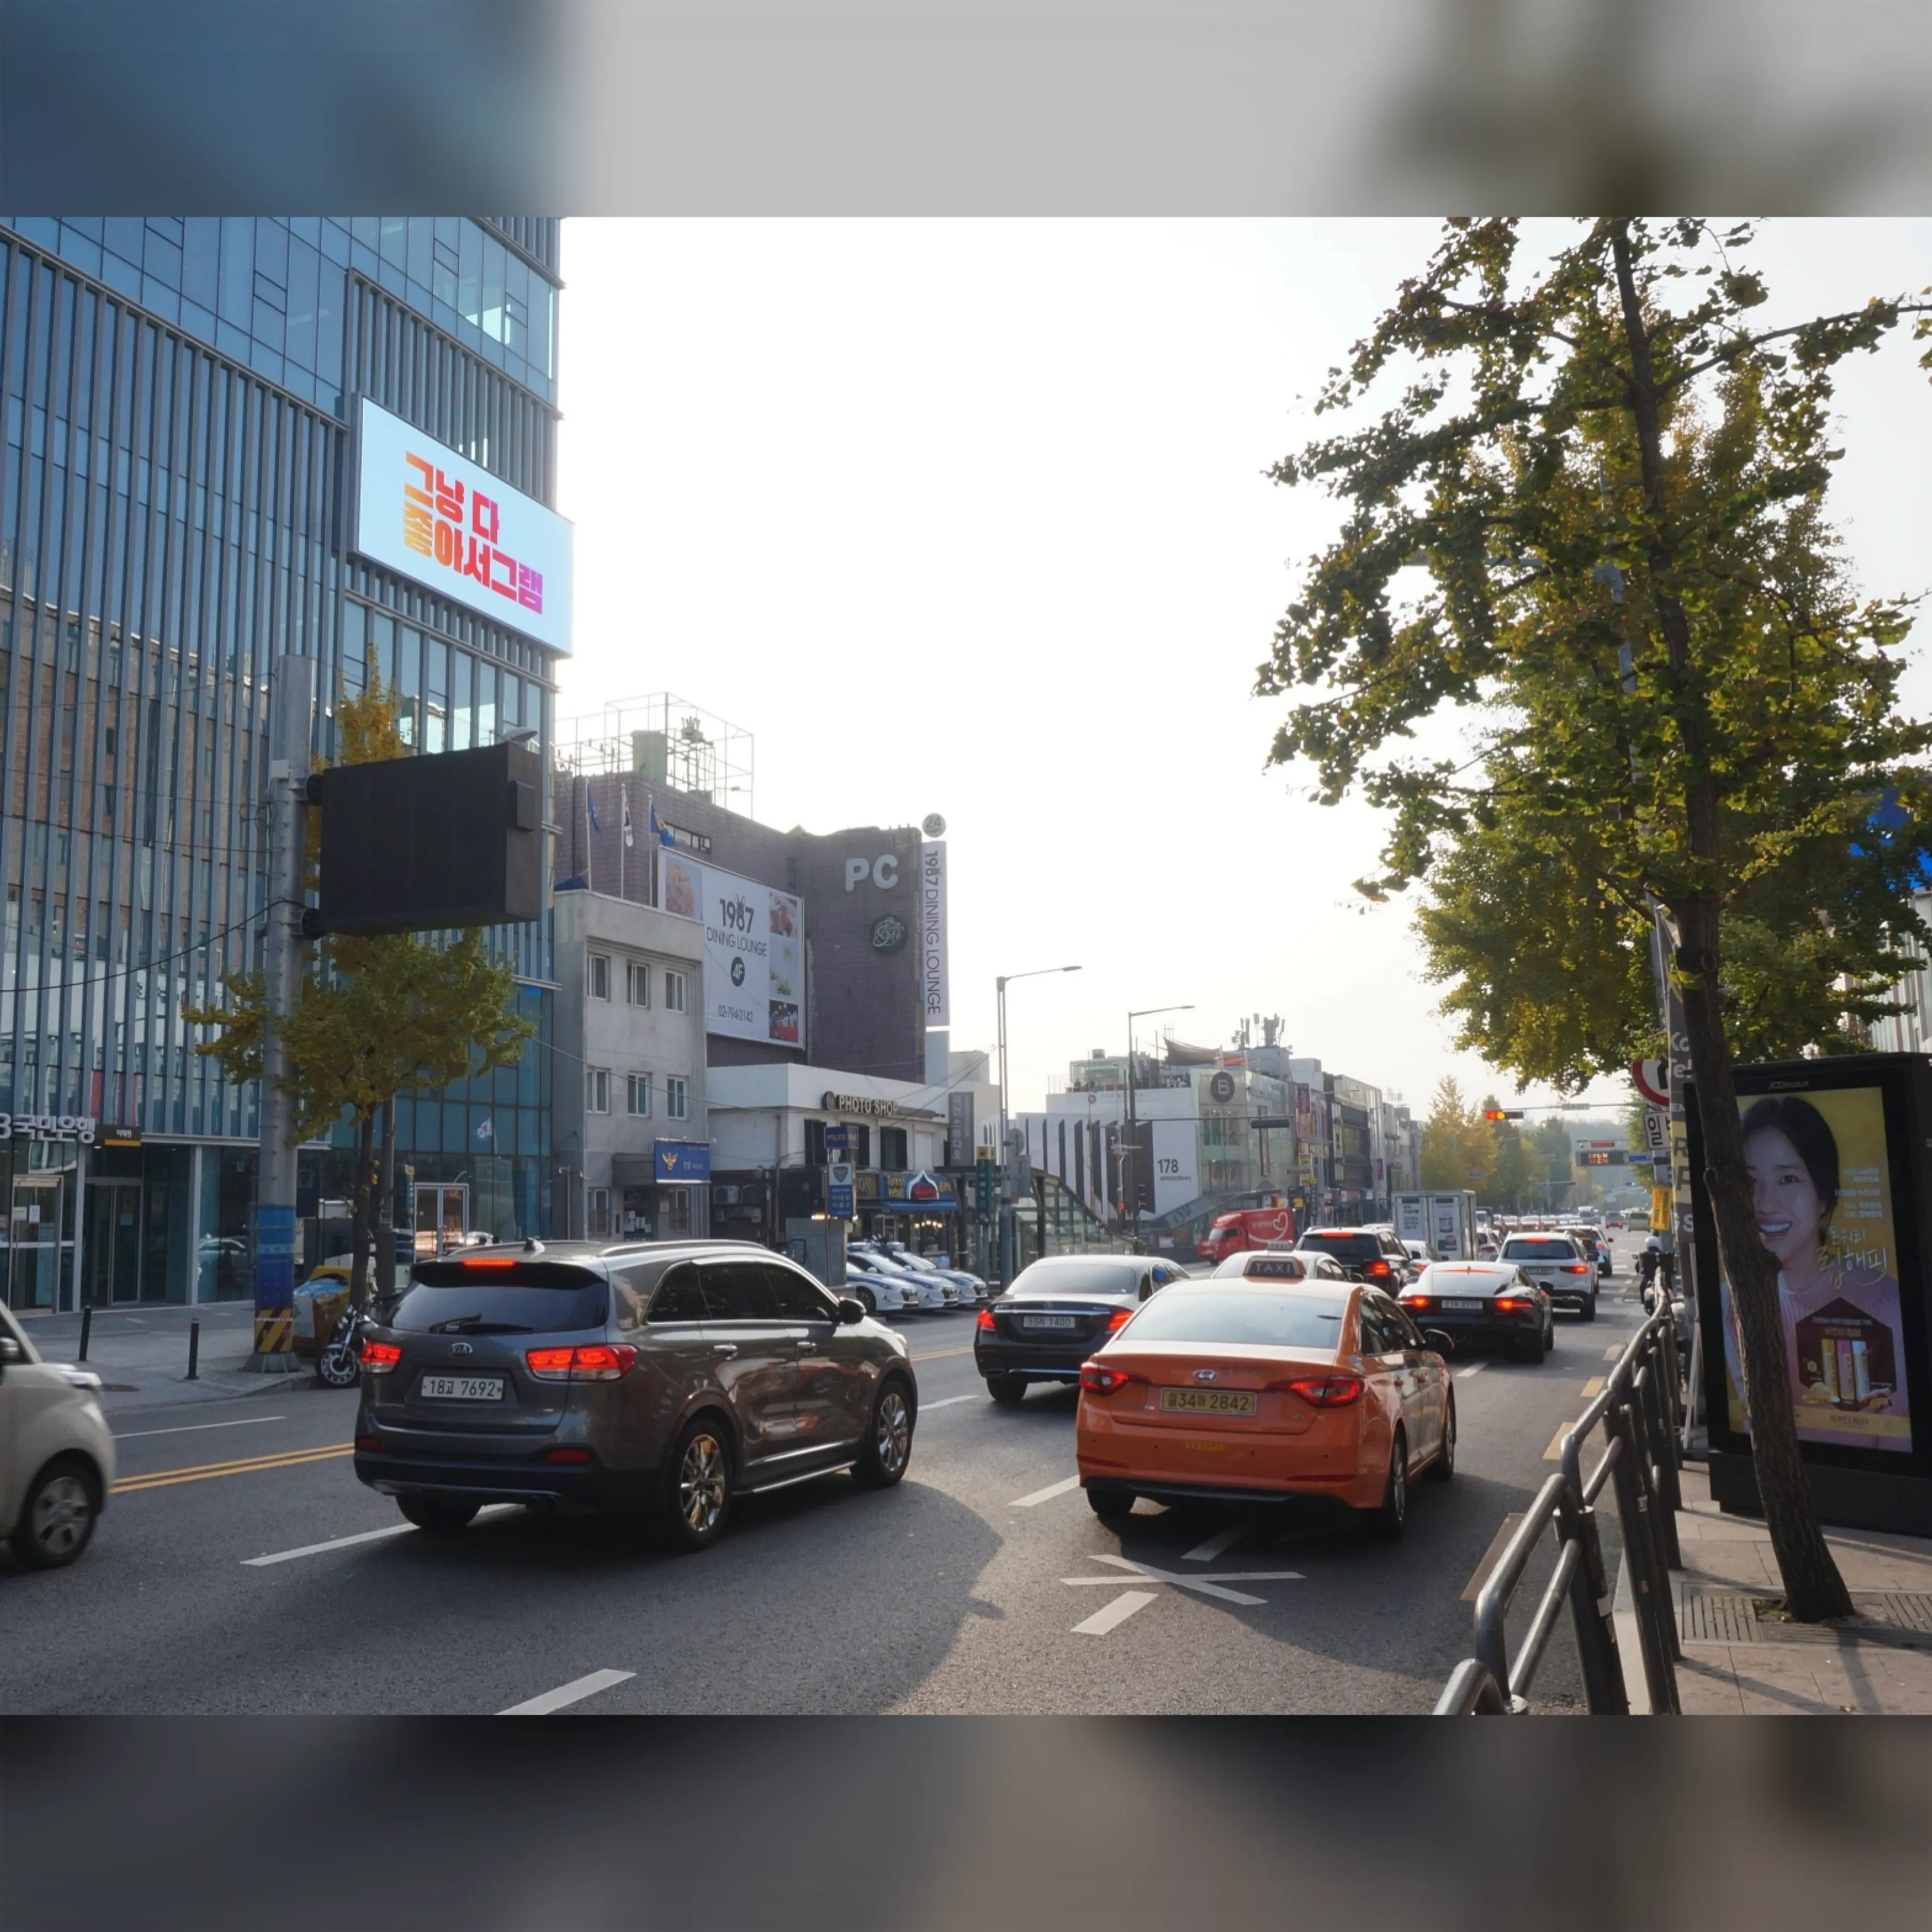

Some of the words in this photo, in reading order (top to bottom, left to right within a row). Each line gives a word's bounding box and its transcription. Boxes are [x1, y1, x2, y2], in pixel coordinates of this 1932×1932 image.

[404, 451, 464, 523] 그냥
[471, 488, 499, 545] 다
[845, 854, 898, 892] PC
[925, 851, 941, 886] 1987
[719, 895, 755, 934] 1987
[926, 890, 939, 945] DINING
[707, 927, 736, 947] DINING
[737, 937, 767, 956] LOUNGE
[926, 950, 940, 1014] LOUNGE
[1217, 1080, 1230, 1095] B
[839, 1095, 872, 1114] PHOTO
[874, 1100, 899, 1116] SHOP
[1157, 1159, 1179, 1174] 178
[1256, 1262, 1291, 1273] TAXI
[461, 1381, 495, 1397] 7692
[1210, 1394, 1249, 1411] 2842
